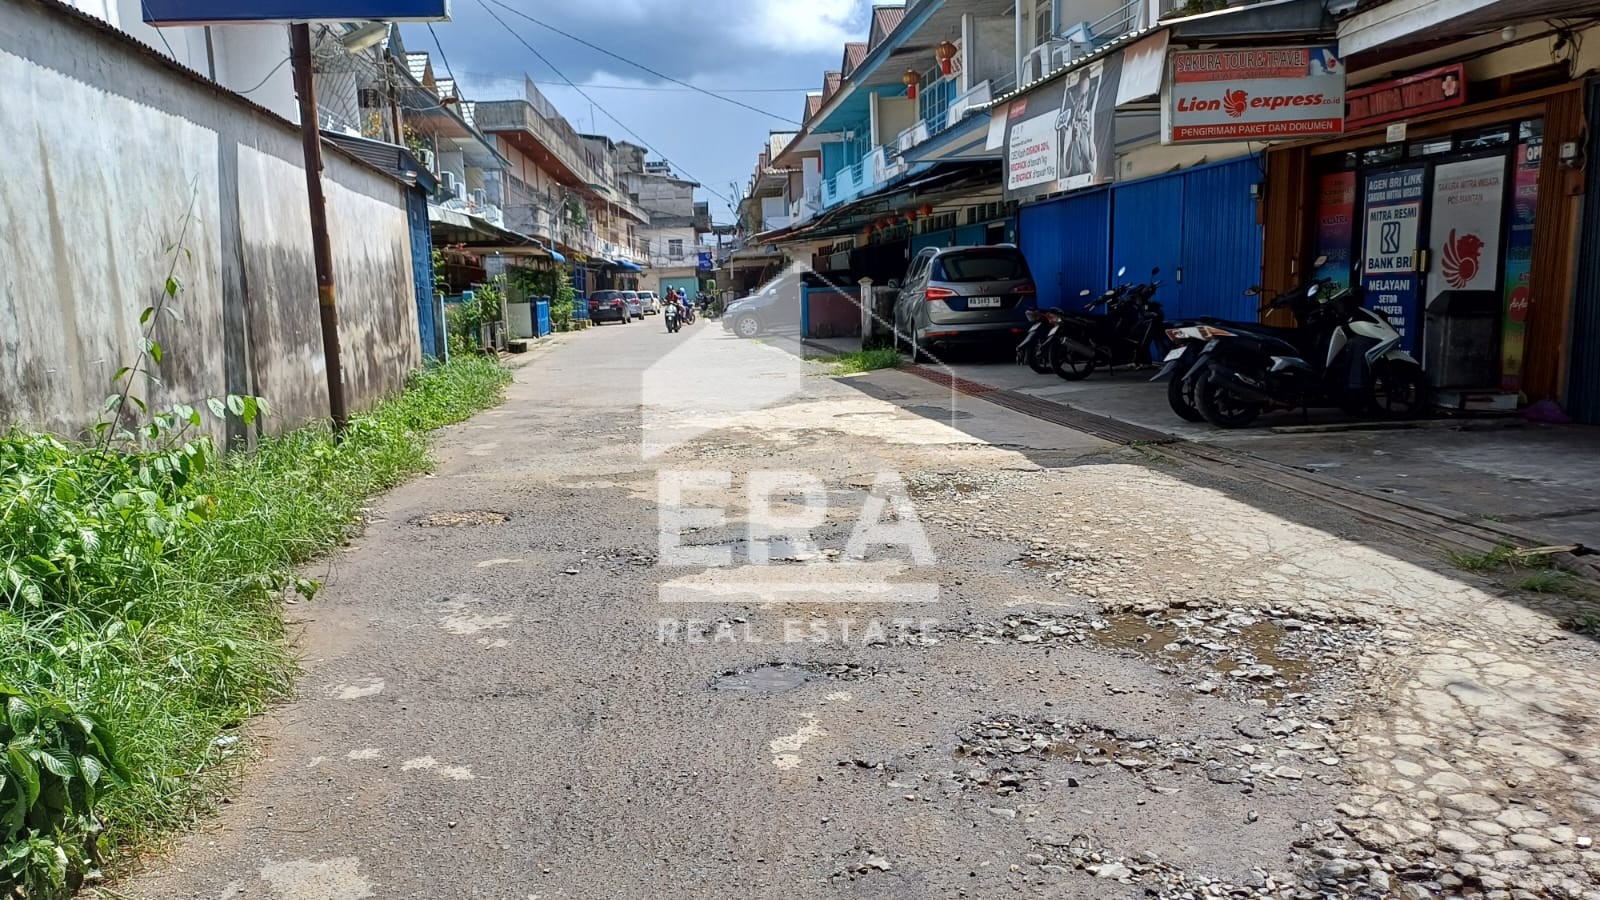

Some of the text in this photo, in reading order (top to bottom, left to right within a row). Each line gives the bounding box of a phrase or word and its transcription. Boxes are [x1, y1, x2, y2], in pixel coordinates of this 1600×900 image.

[1177, 50, 1306, 71] SAKURA TOUR & TRAVEL
[1177, 96, 1220, 112] Lion
[1181, 120, 1333, 136] PENGIRIMAN PAKET DAN DOKUMEN
[1368, 174, 1423, 191] AGEN BRI LINK
[1370, 207, 1417, 222] MITRA RESMI
[1368, 256, 1412, 269] BANK BRI
[1368, 280, 1410, 291] MELAYANI
[1378, 295, 1397, 303] SETOR
